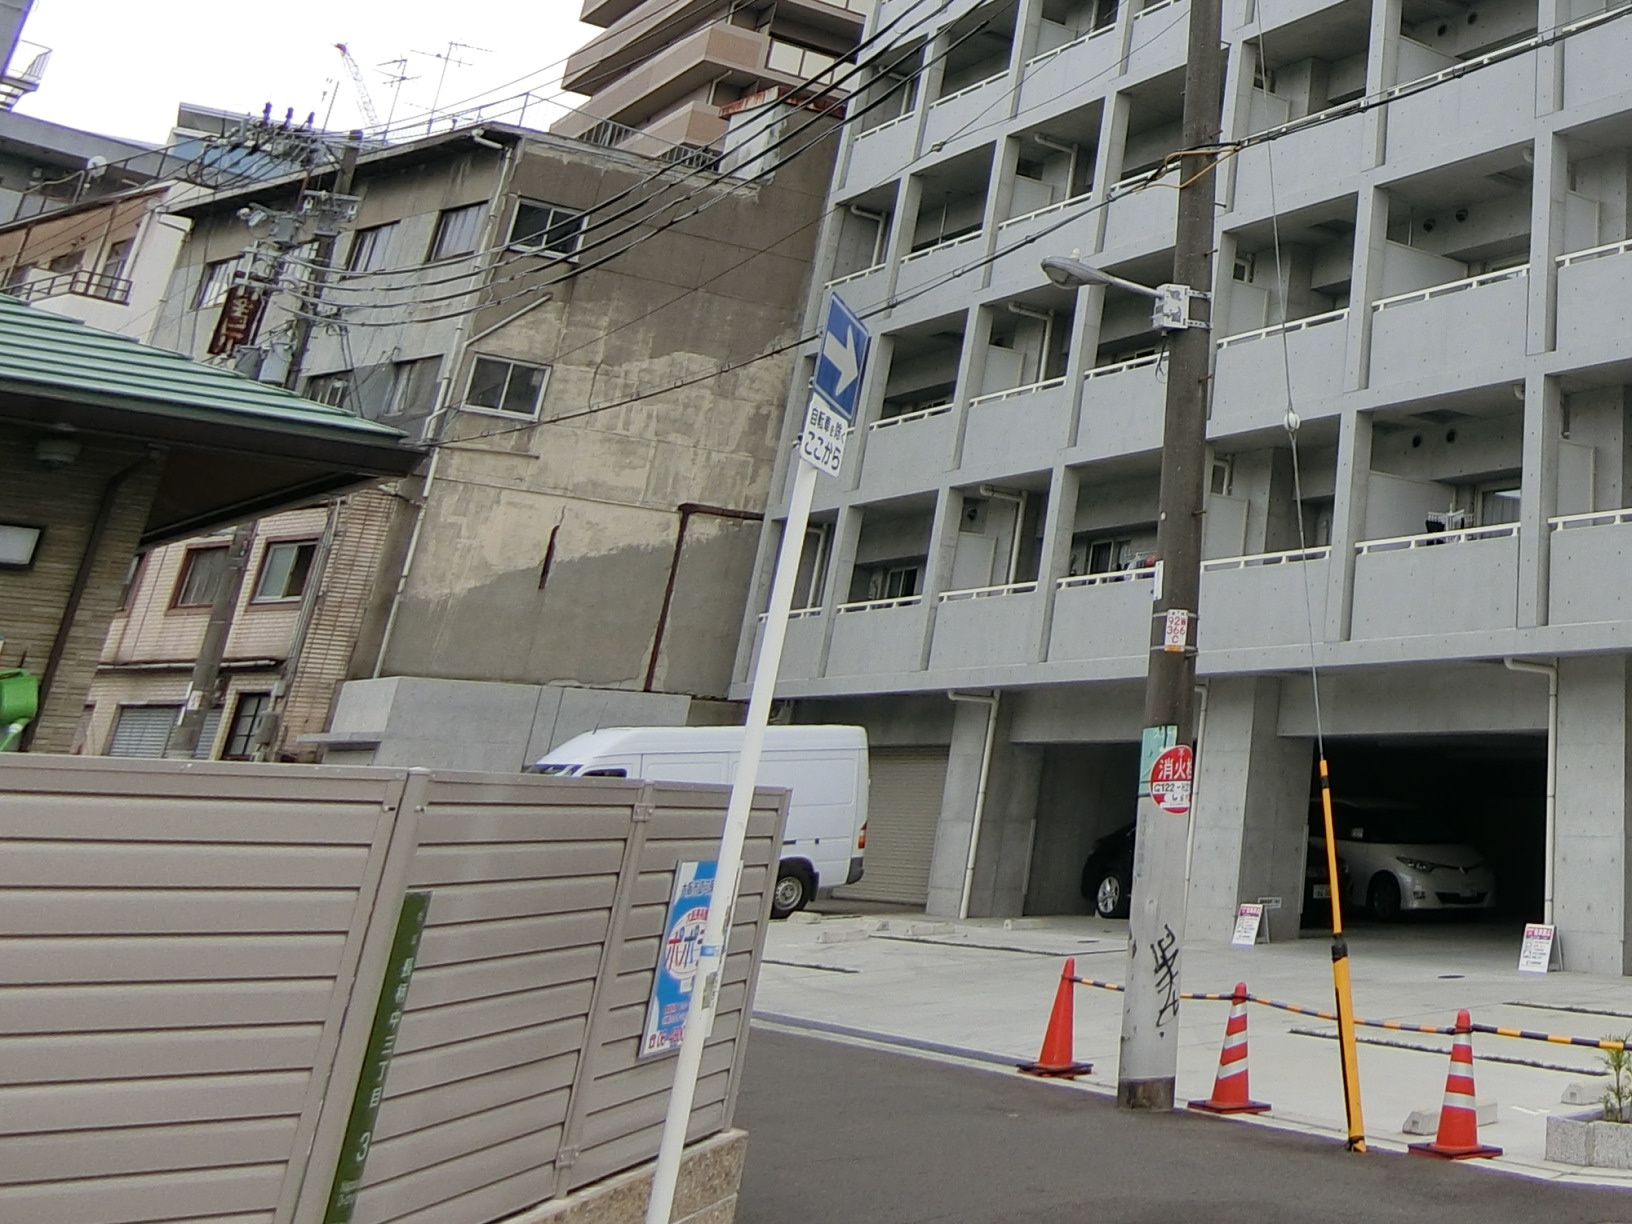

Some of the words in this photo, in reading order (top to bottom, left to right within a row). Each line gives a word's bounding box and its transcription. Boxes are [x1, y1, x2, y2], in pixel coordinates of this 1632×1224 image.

[810, 408, 845, 440] 自転車を除く
[805, 432, 841, 470] ここから
[1167, 625, 1185, 635] 366
[1171, 635, 1179, 644] C
[356, 1131, 371, 1162] 3
